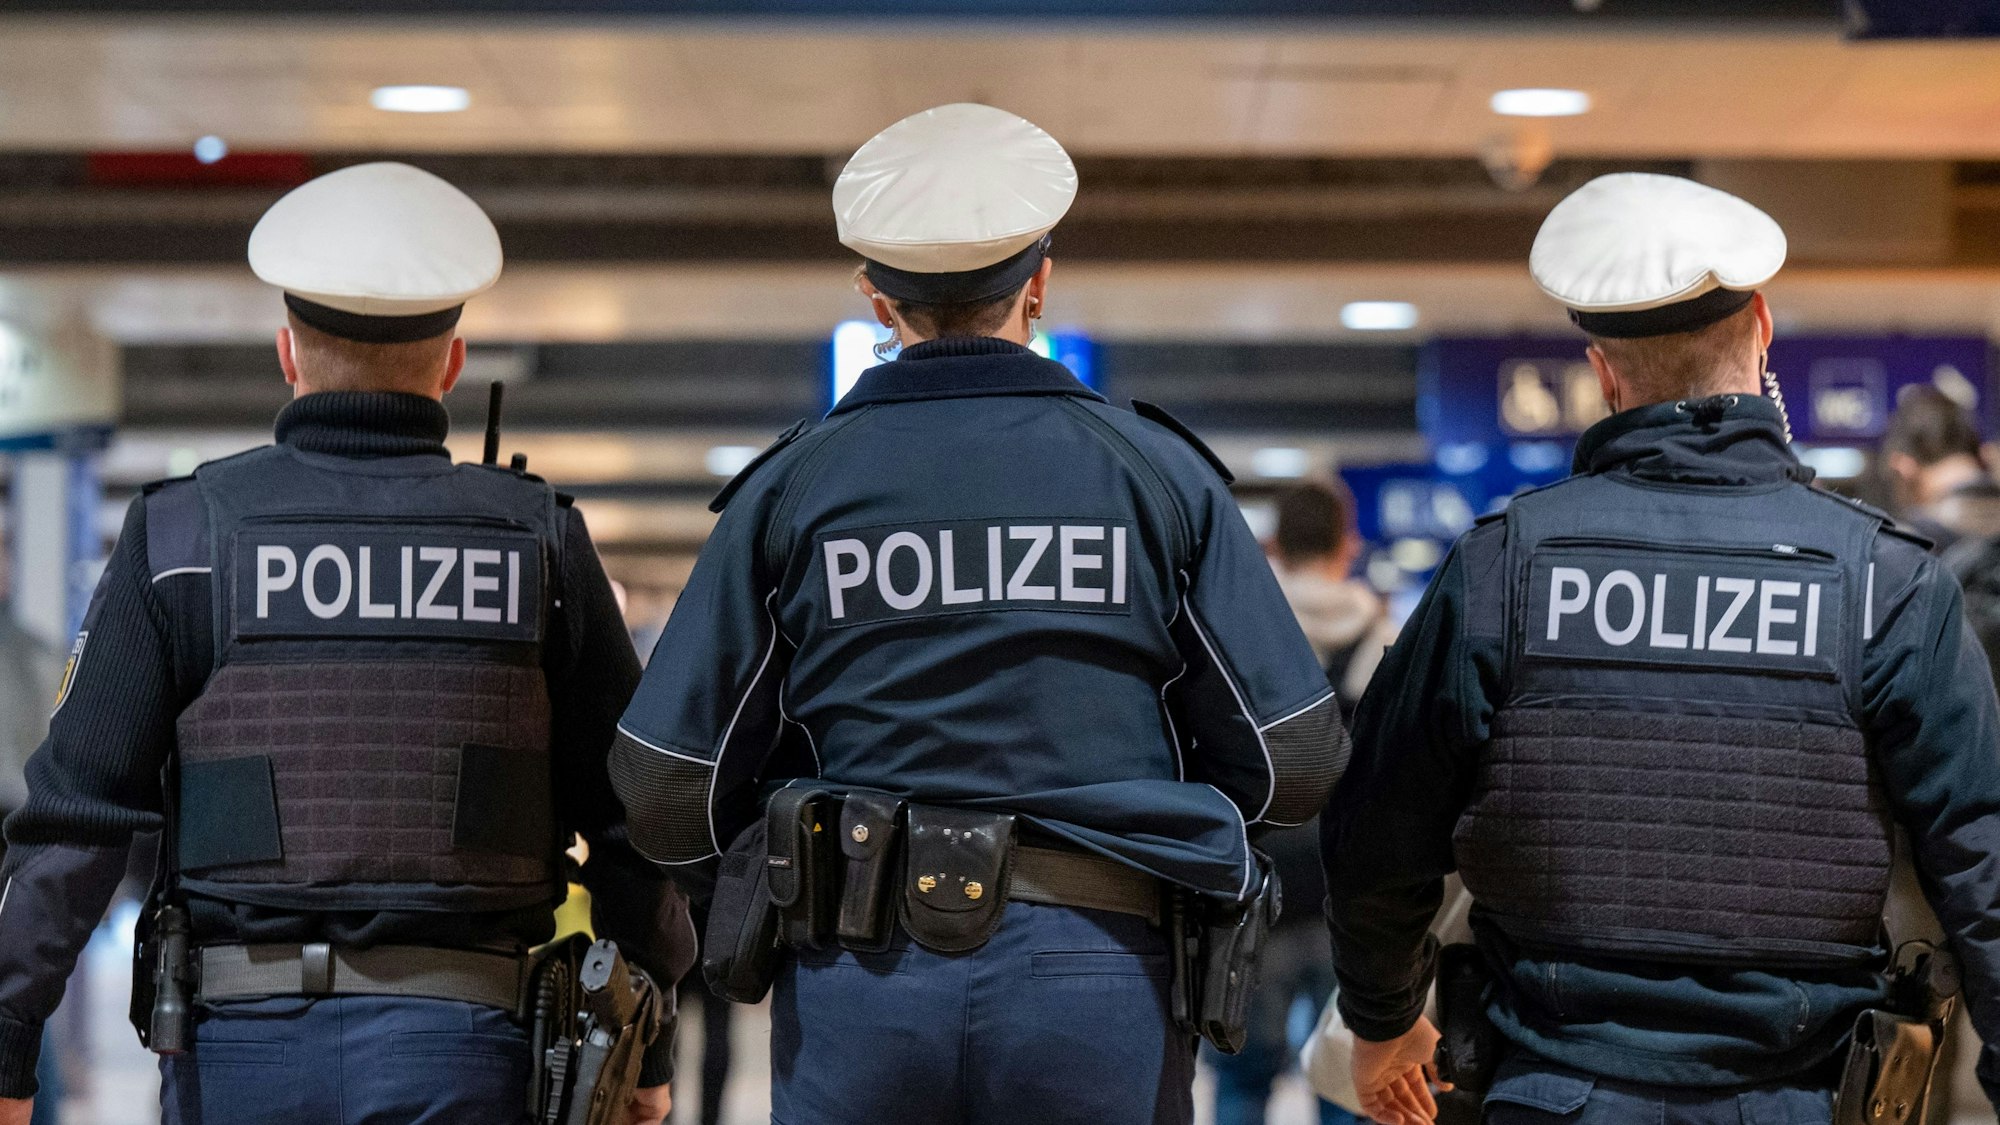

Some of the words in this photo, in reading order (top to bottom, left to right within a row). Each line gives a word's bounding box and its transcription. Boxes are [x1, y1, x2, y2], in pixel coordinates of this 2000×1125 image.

[256, 544, 519, 623] POLIZEI
[824, 526, 1126, 618] POLIZEI
[1547, 567, 1821, 657] POLIZEI
